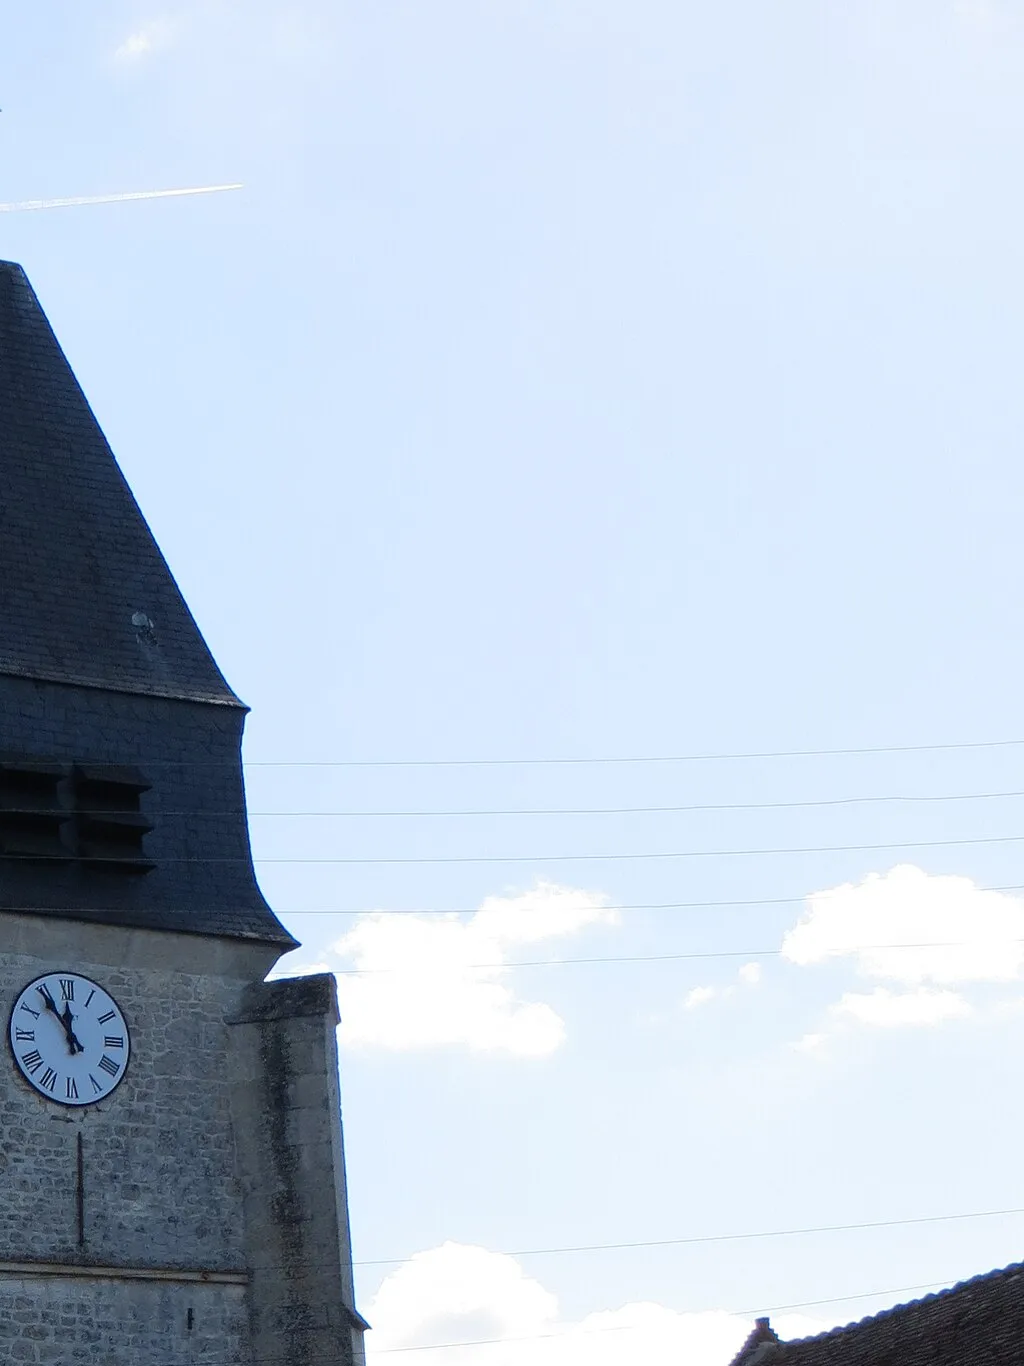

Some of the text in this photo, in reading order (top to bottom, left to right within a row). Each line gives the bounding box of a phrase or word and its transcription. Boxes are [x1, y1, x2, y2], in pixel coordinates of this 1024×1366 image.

[59, 980, 74, 1001] XII
[84, 990, 96, 1008] I
[20, 1002, 40, 1020] X
[97, 1010, 116, 1024] II
[16, 1027, 34, 1041] IX
[104, 1036, 123, 1048] III
[22, 1049, 44, 1075] VIII
[98, 1055, 120, 1077] IIII
[40, 1067, 58, 1092] VII
[66, 1077, 79, 1098] VI
[89, 1074, 103, 1094] V
